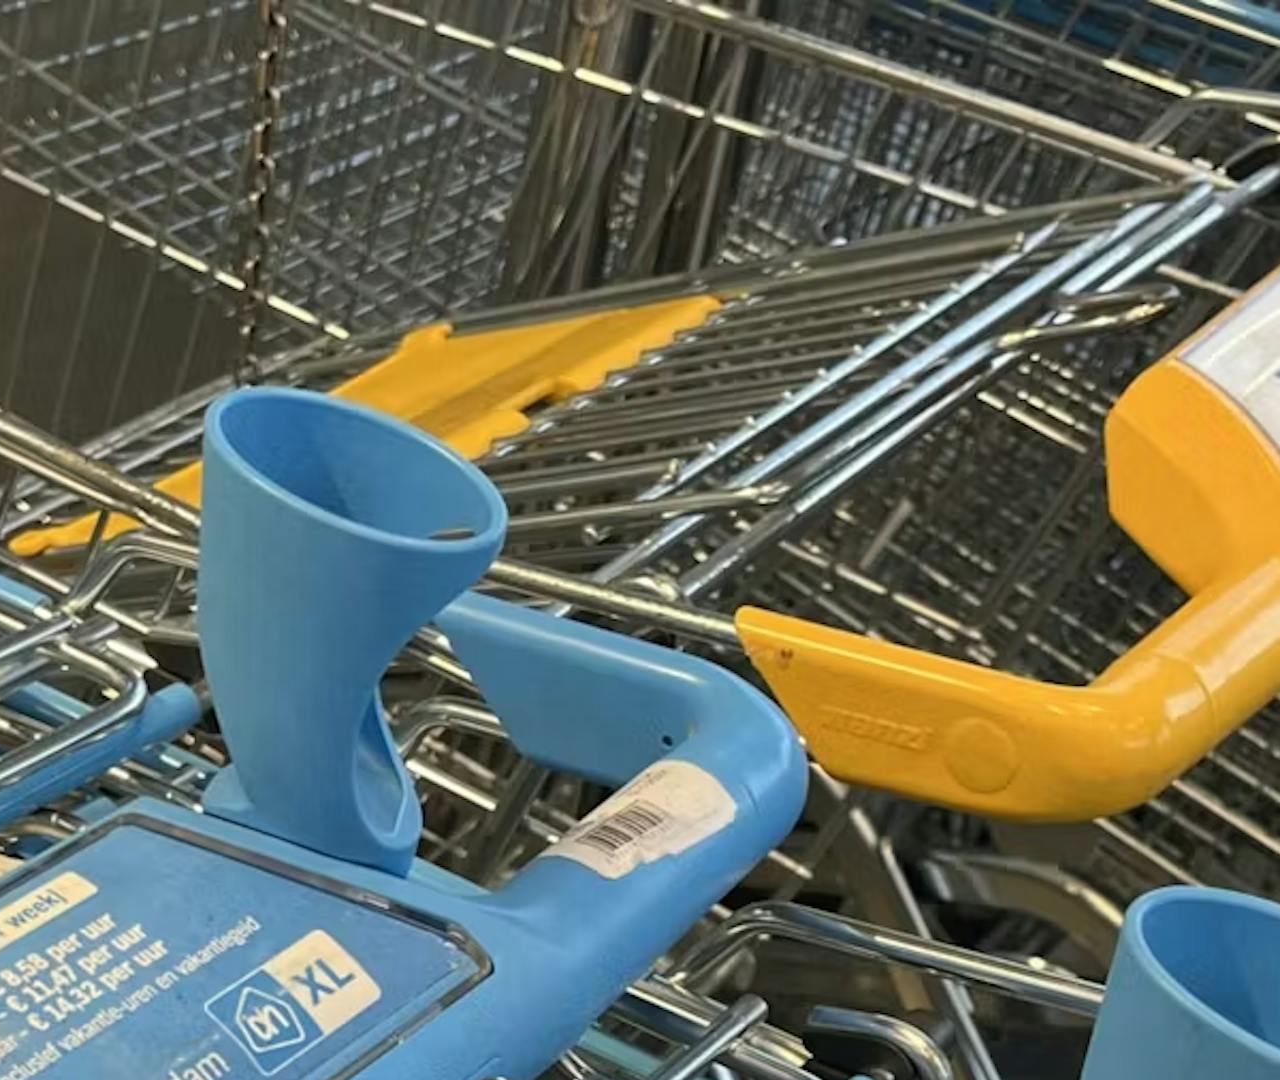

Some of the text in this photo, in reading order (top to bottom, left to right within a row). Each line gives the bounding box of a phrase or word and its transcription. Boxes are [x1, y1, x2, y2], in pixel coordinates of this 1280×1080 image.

[0, 953, 49, 987] 8,58
[46, 932, 83, 962] per
[80, 912, 116, 940] uur
[6, 996, 28, 1013] €
[22, 965, 78, 1003] 11,47
[78, 945, 113, 974] per
[111, 924, 147, 951] uur
[27, 1013, 50, 1031] €
[44, 980, 102, 1022] 14,32
[100, 960, 135, 991] per
[133, 940, 169, 968] uur
[59, 985, 158, 1050] vakantie-uren
[155, 971, 179, 989] en
[176, 915, 262, 976] vakantiegeld
[291, 959, 356, 1006] XL
